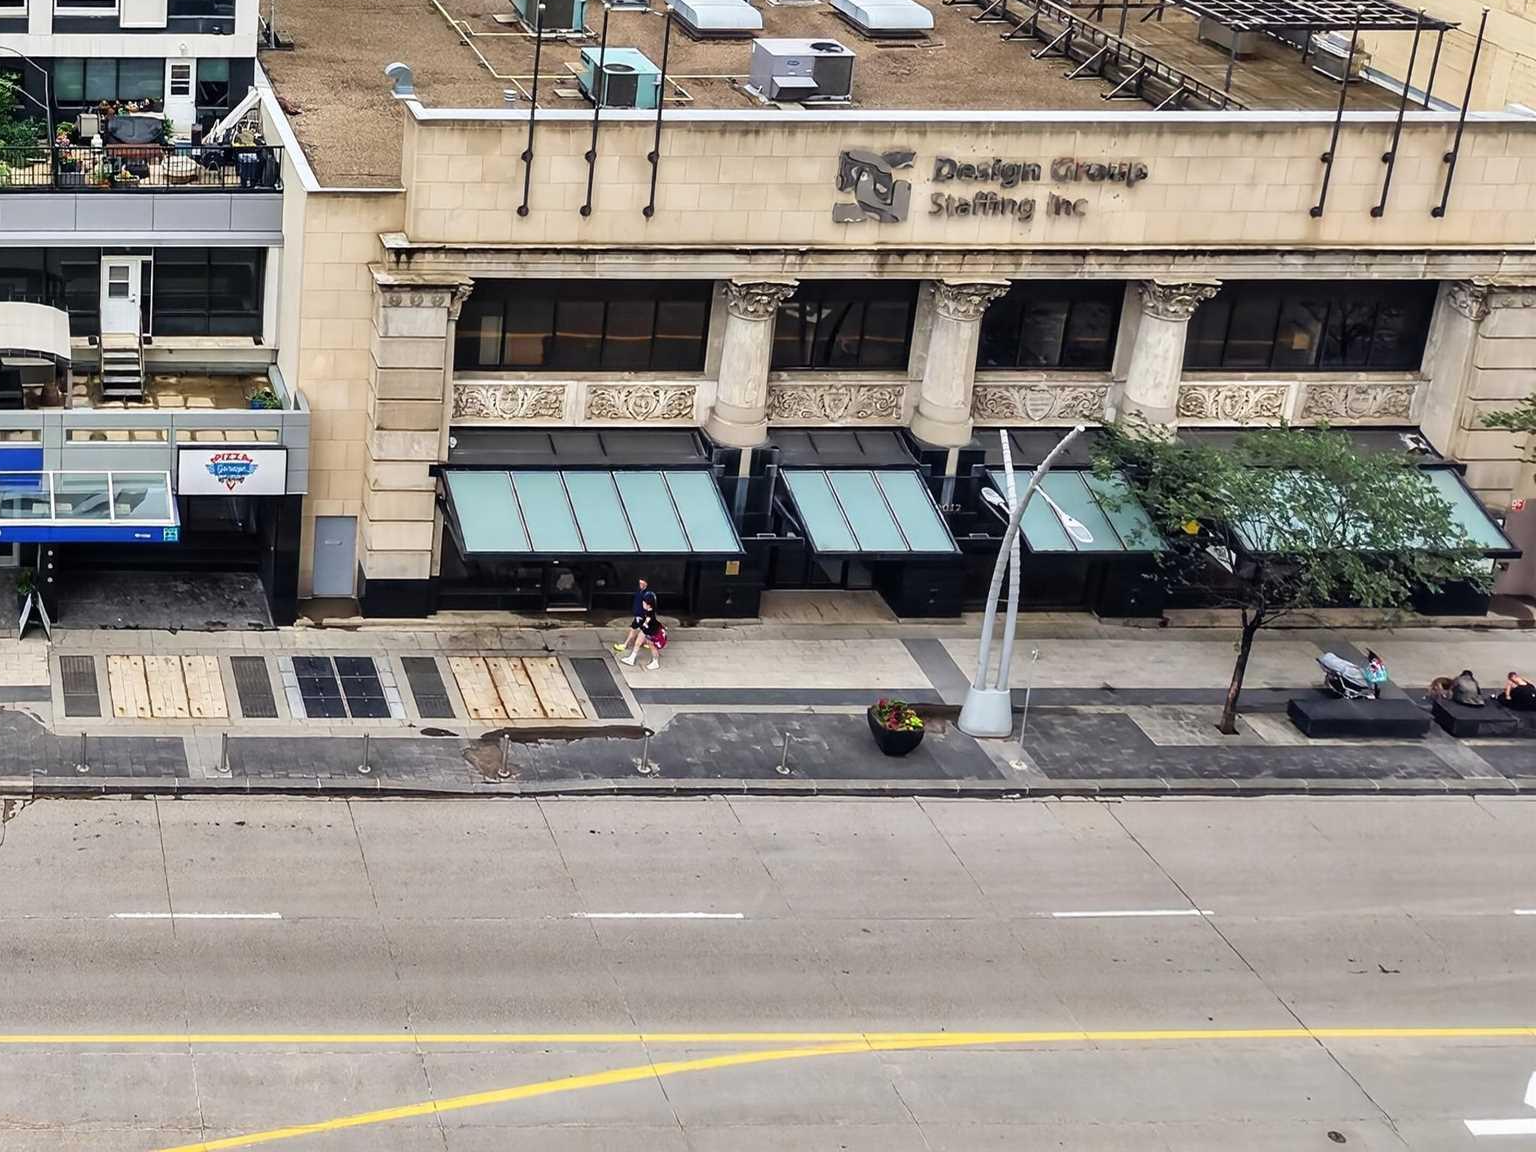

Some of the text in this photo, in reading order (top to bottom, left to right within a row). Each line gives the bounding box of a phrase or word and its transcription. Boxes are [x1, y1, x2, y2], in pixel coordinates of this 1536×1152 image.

[932, 156, 1149, 188] Design Group
[929, 191, 1089, 222] Staffing Inc
[210, 452, 253, 463] PIZZA
